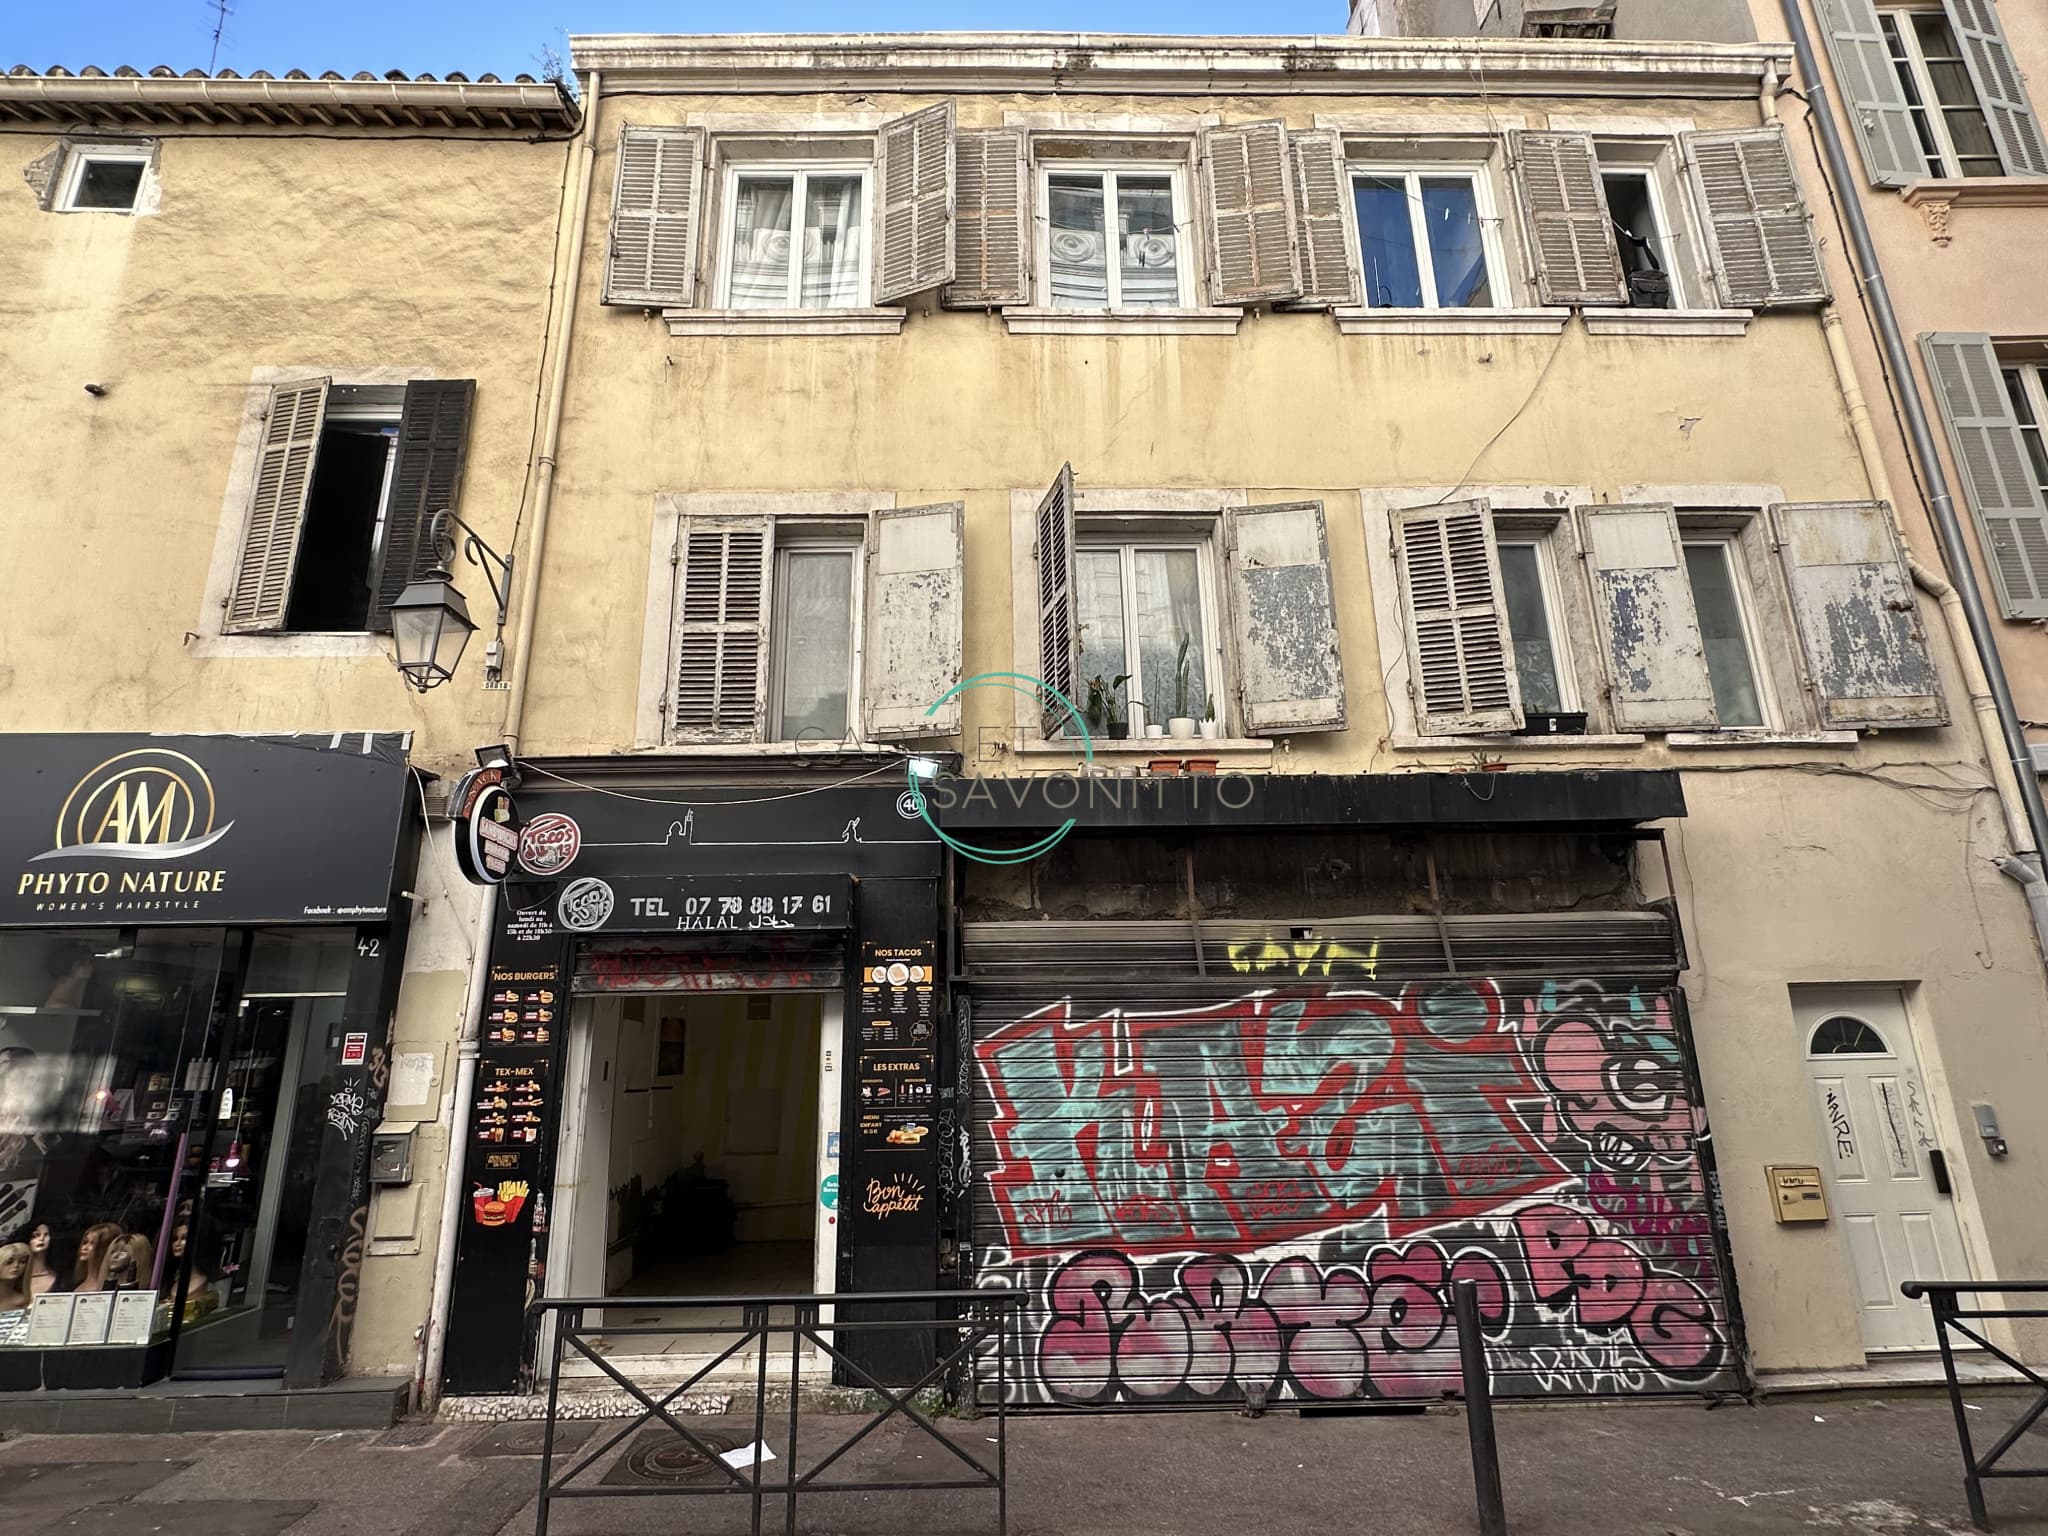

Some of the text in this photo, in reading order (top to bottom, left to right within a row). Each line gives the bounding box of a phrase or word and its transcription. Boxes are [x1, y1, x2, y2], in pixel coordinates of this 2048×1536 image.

[903, 797, 922, 811] 40
[93, 781, 177, 845] AM
[17, 870, 226, 895] PHYTO NATURE
[36, 900, 201, 911] WOMEN'S HAIRSTYLE
[630, 898, 670, 916] TEL
[685, 897, 712, 915] 07
[782, 895, 804, 914] 17
[812, 894, 831, 913] 61
[676, 915, 739, 930] HALAL
[357, 937, 380, 957] 42
[875, 948, 923, 957] NOS TACOS
[494, 971, 556, 981] NOS BURGERS
[495, 1067, 535, 1076] TEX-MEX
[873, 1062, 921, 1072] LES EXTRAS
[865, 1178, 905, 1204] Bon
